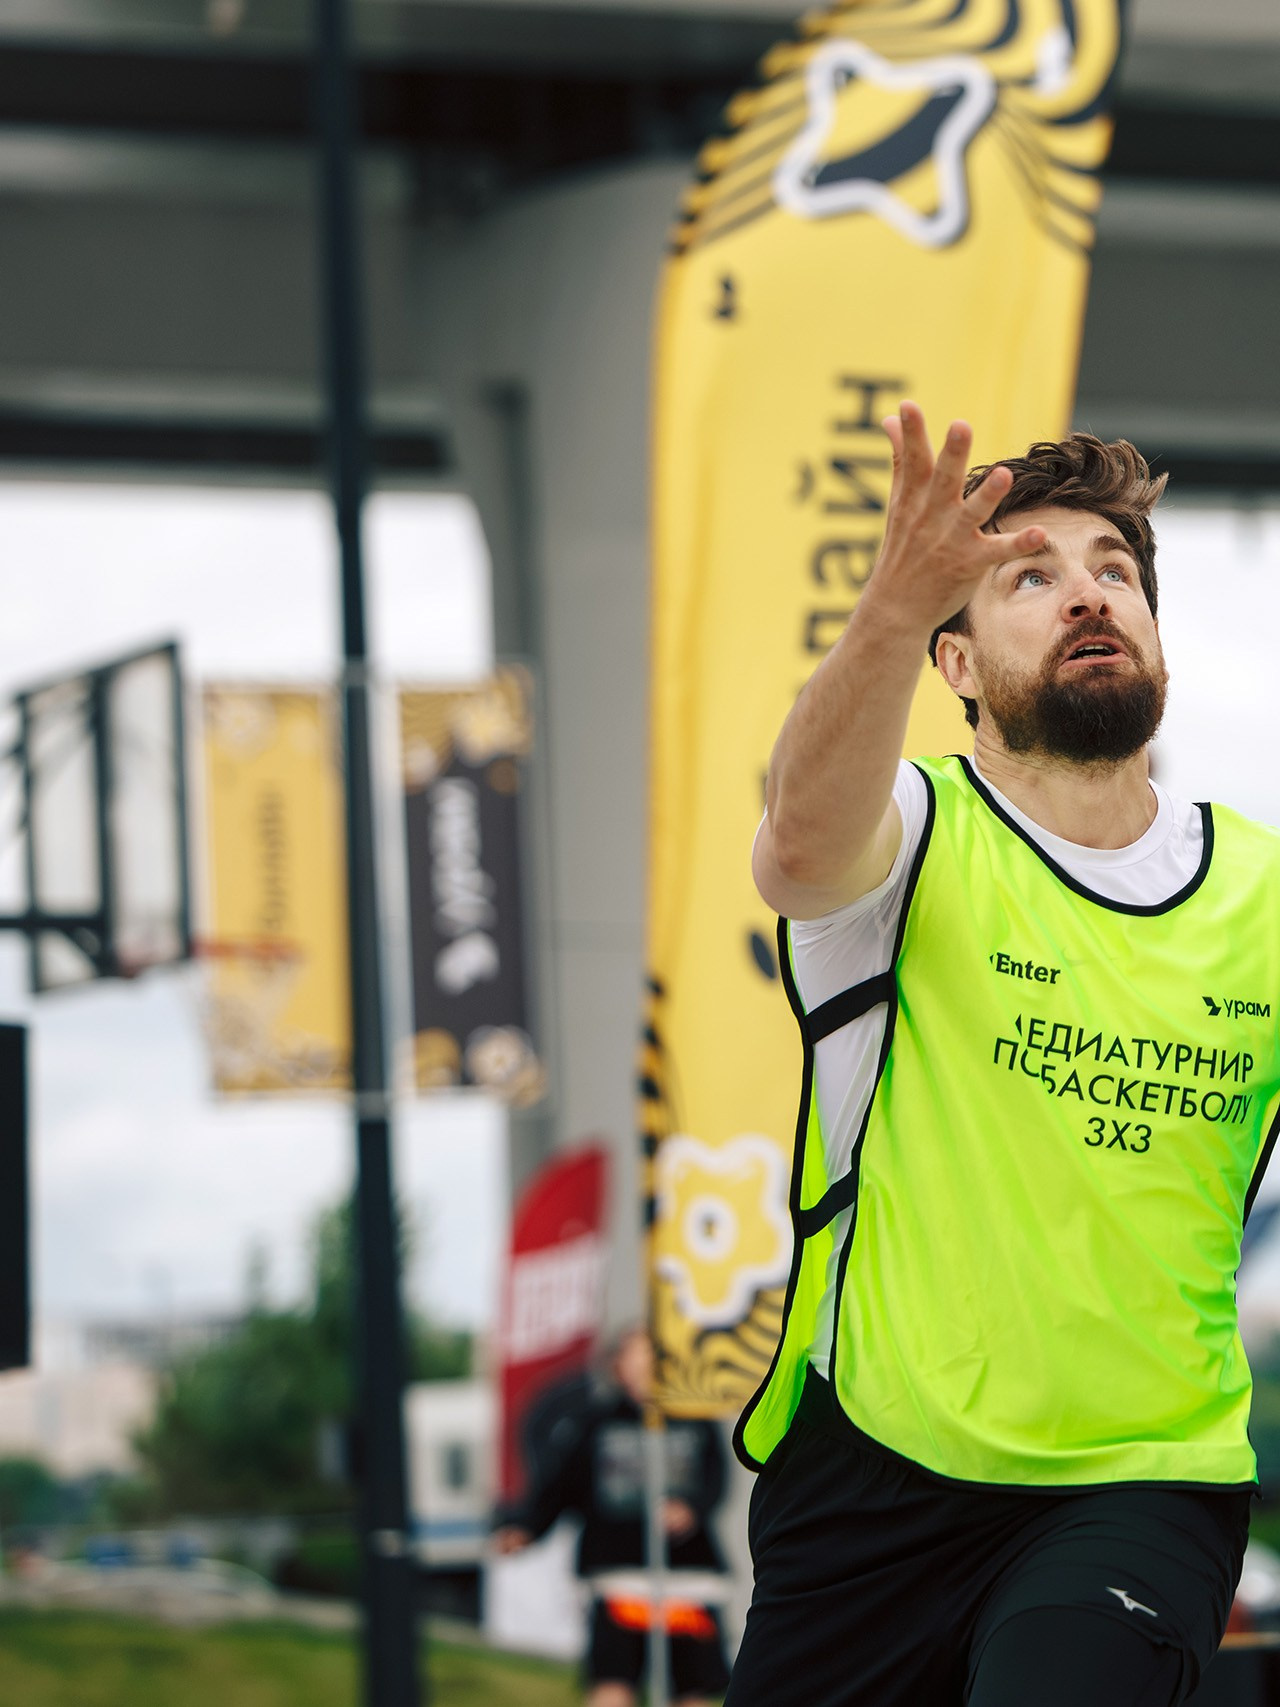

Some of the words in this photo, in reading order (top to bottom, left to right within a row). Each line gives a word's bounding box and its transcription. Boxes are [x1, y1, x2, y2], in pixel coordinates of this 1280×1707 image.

[995, 952, 1061, 984] Enter
[1223, 998, 1271, 1019] урам
[1015, 1013, 1254, 1083] ЕДИАТУРНИР
[1041, 1064, 1253, 1124] БАСКЕТБОЛУ
